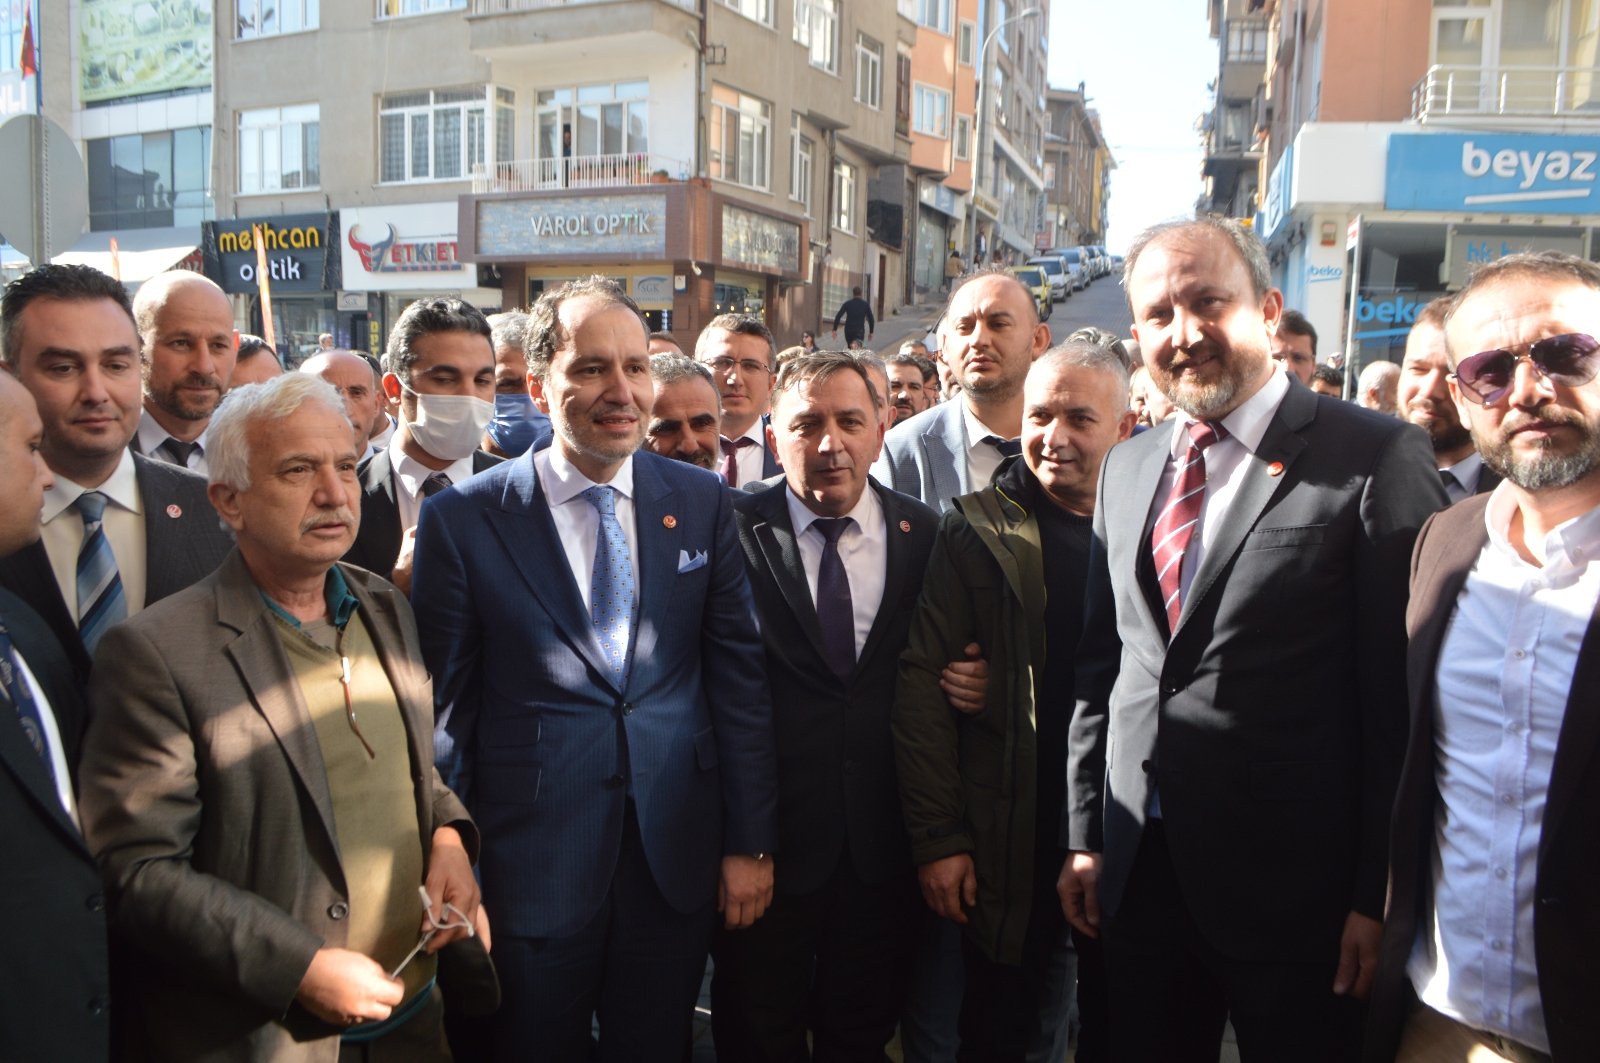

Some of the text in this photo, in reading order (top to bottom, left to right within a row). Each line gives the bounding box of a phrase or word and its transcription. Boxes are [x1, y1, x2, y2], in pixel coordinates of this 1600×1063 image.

[1461, 140, 1597, 189] beyaz
[530, 215, 589, 236] VAROL
[1309, 265, 1343, 277] beko
[641, 283, 660, 293] SGK
